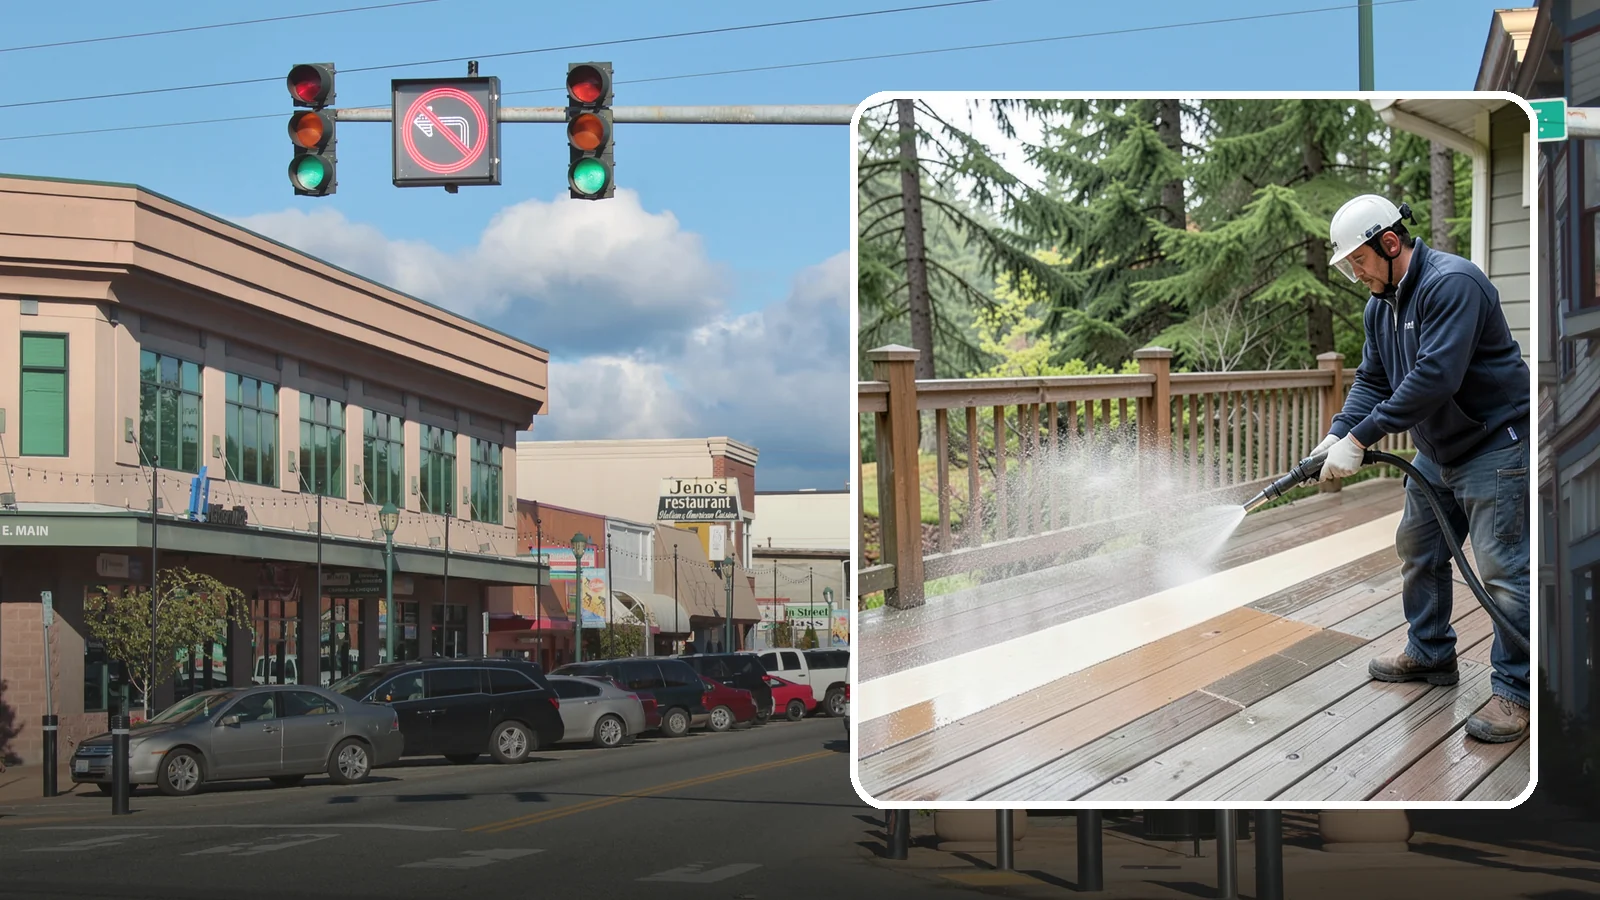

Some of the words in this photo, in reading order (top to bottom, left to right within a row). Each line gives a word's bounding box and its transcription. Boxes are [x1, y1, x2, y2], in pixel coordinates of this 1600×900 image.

[670, 480, 727, 494] Jeno's
[665, 496, 731, 509] restaurant
[659, 510, 681, 519] Italian
[686, 510, 714, 519] American
[715, 510, 738, 519] Cuisine
[2, 525, 13, 536] E.
[15, 525, 49, 536] MAIN
[797, 607, 828, 617] Street
